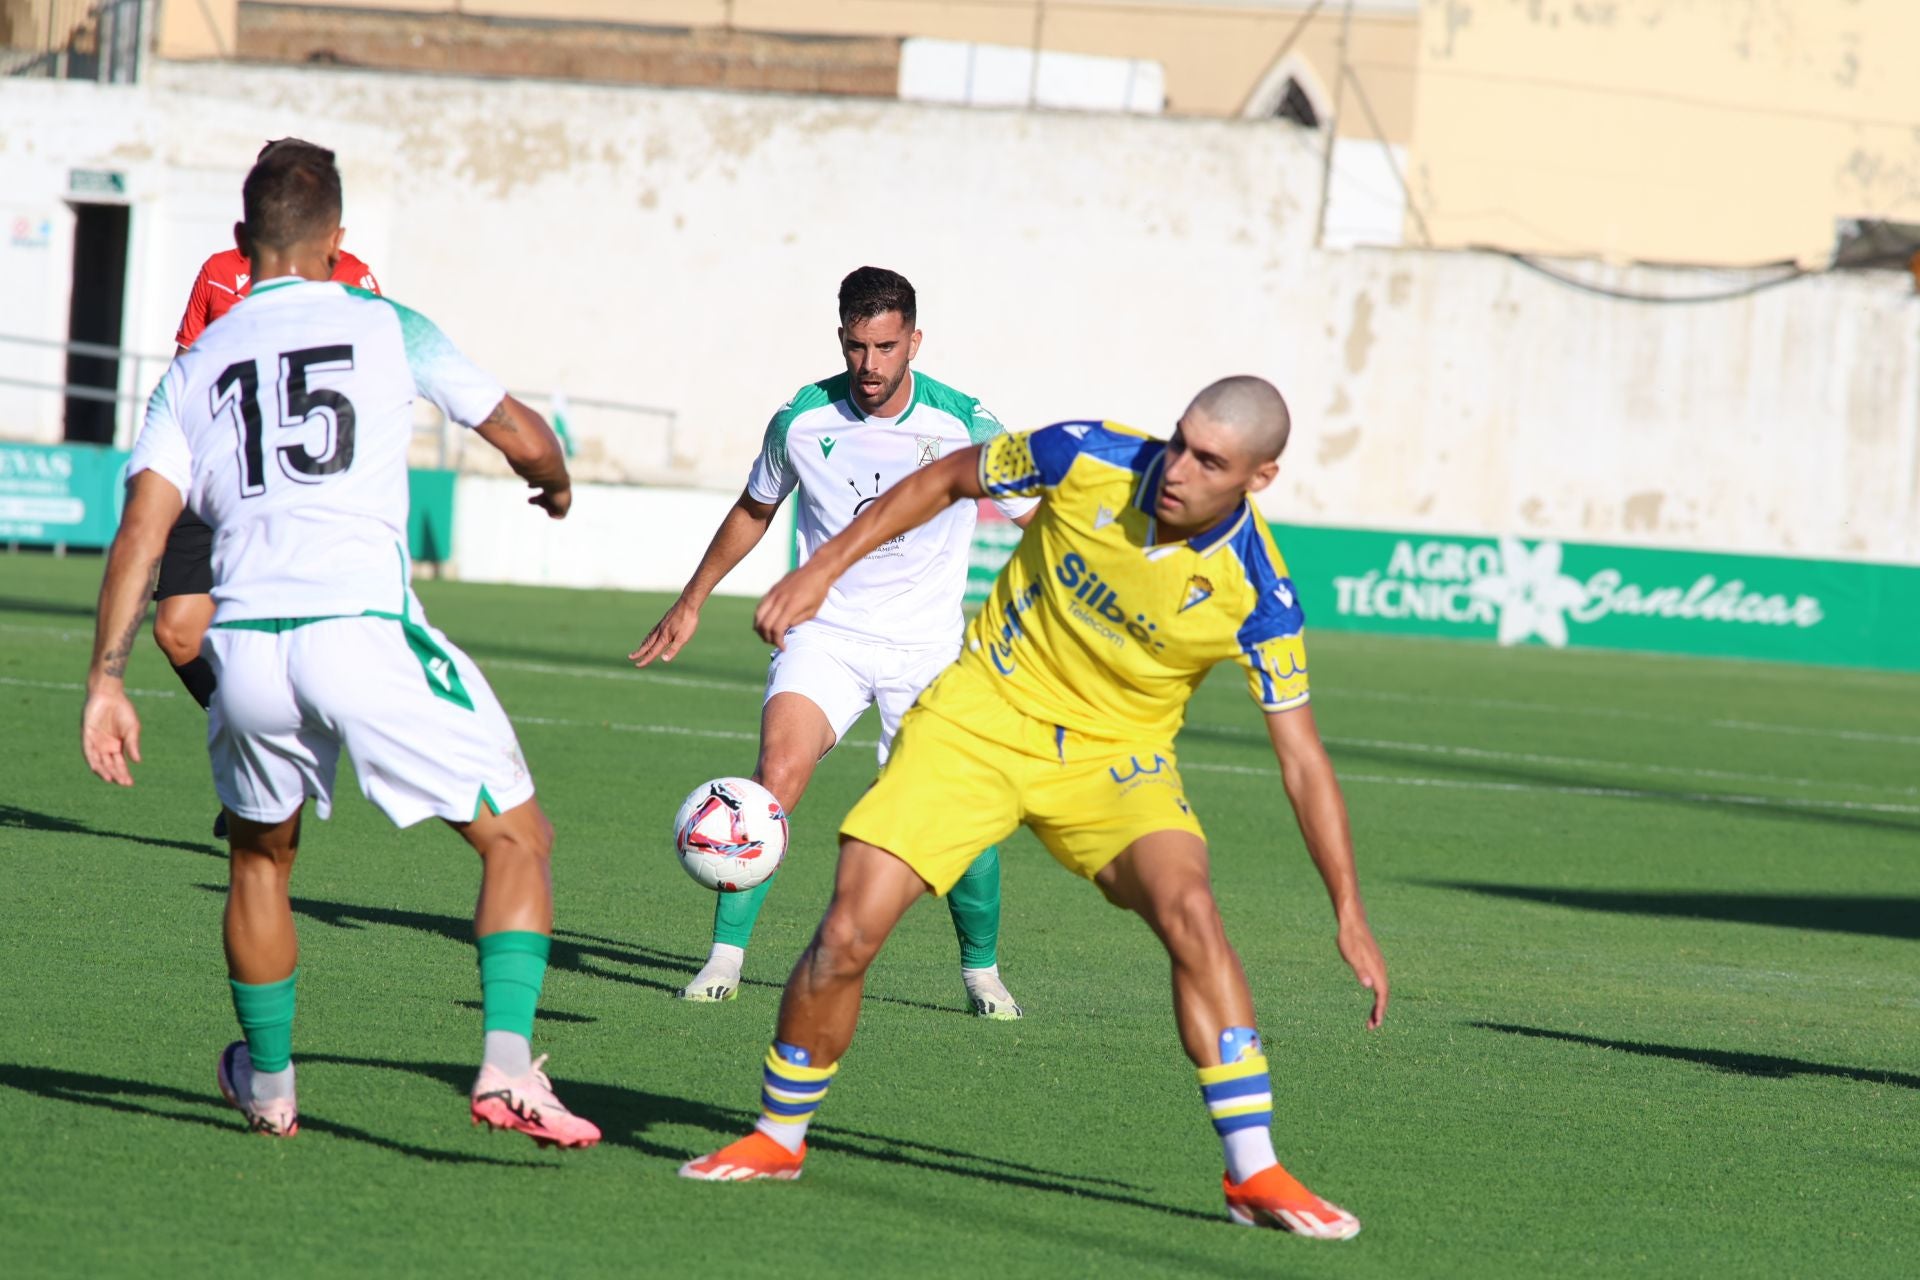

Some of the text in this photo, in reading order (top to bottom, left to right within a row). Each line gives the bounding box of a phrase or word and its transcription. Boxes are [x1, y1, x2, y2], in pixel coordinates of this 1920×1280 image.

[209, 344, 356, 499] 15
[1387, 540, 1499, 581] AGRO
[1333, 570, 1497, 624] TÉCNICA
[1067, 600, 1125, 649] Telecom
